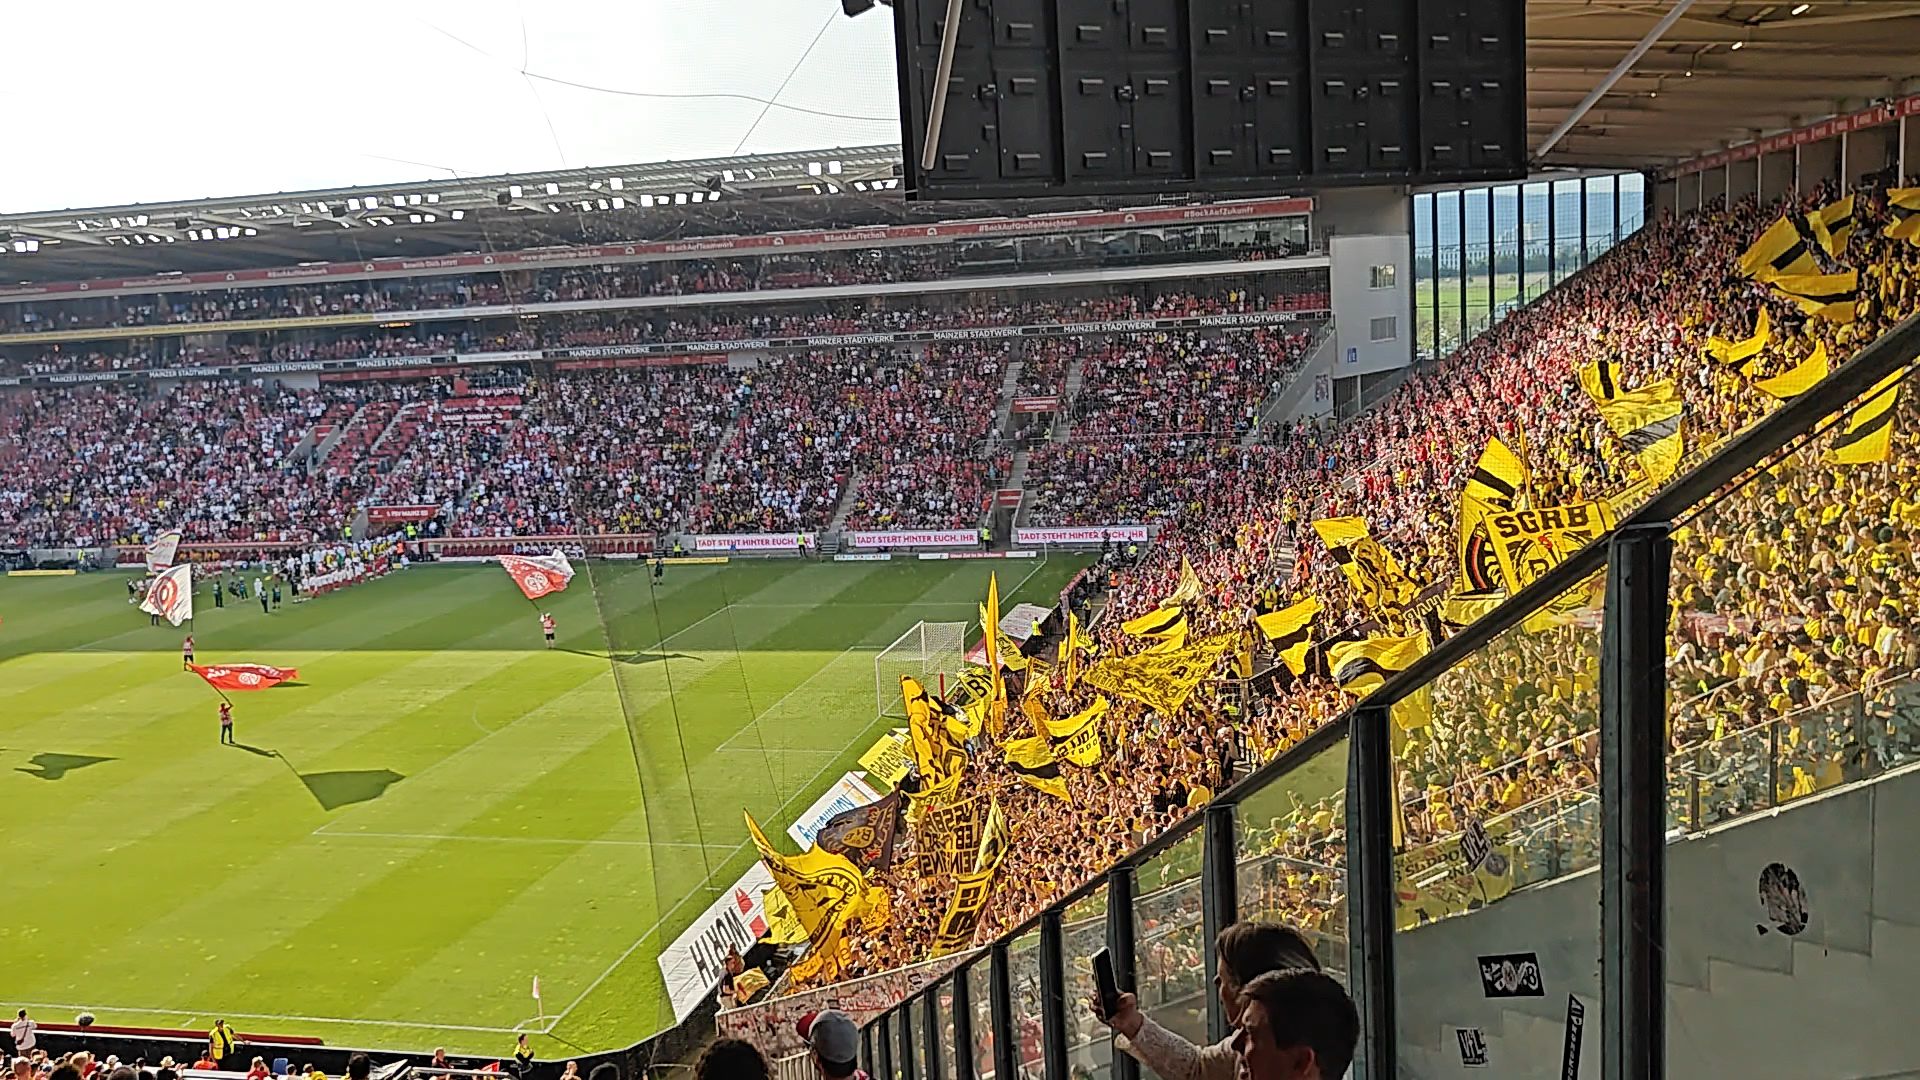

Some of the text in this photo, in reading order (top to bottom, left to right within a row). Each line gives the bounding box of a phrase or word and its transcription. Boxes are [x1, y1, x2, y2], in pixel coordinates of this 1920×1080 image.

[1200, 313, 1297, 326] MAINZER STADTWERKE
[1064, 321, 1157, 333] MAINZER STADTWERKE
[934, 328, 1023, 340] MAINZER STADTWERKE
[687, 341, 770, 351] MAINZER STADTWERKE
[808, 335, 894, 346] MAINZER STADTWERKE
[569, 347, 650, 357] MAINZER STADTWERKE
[251, 362, 324, 373] MAINZER STADTWERKE
[356, 357, 432, 368] MAINZER STADTWERKE
[50, 373, 119, 383] MAINZER STADTWERKE
[150, 367, 220, 378] MAINZER STADTWERKE
[1494, 505, 1589, 538] SGRB
[903, 534, 932, 543] HINTER
[960, 533, 975, 541] IHR
[1042, 532, 1066, 540] STEHT
[1069, 531, 1099, 540] HINTER
[743, 538, 770, 546] HINTER
